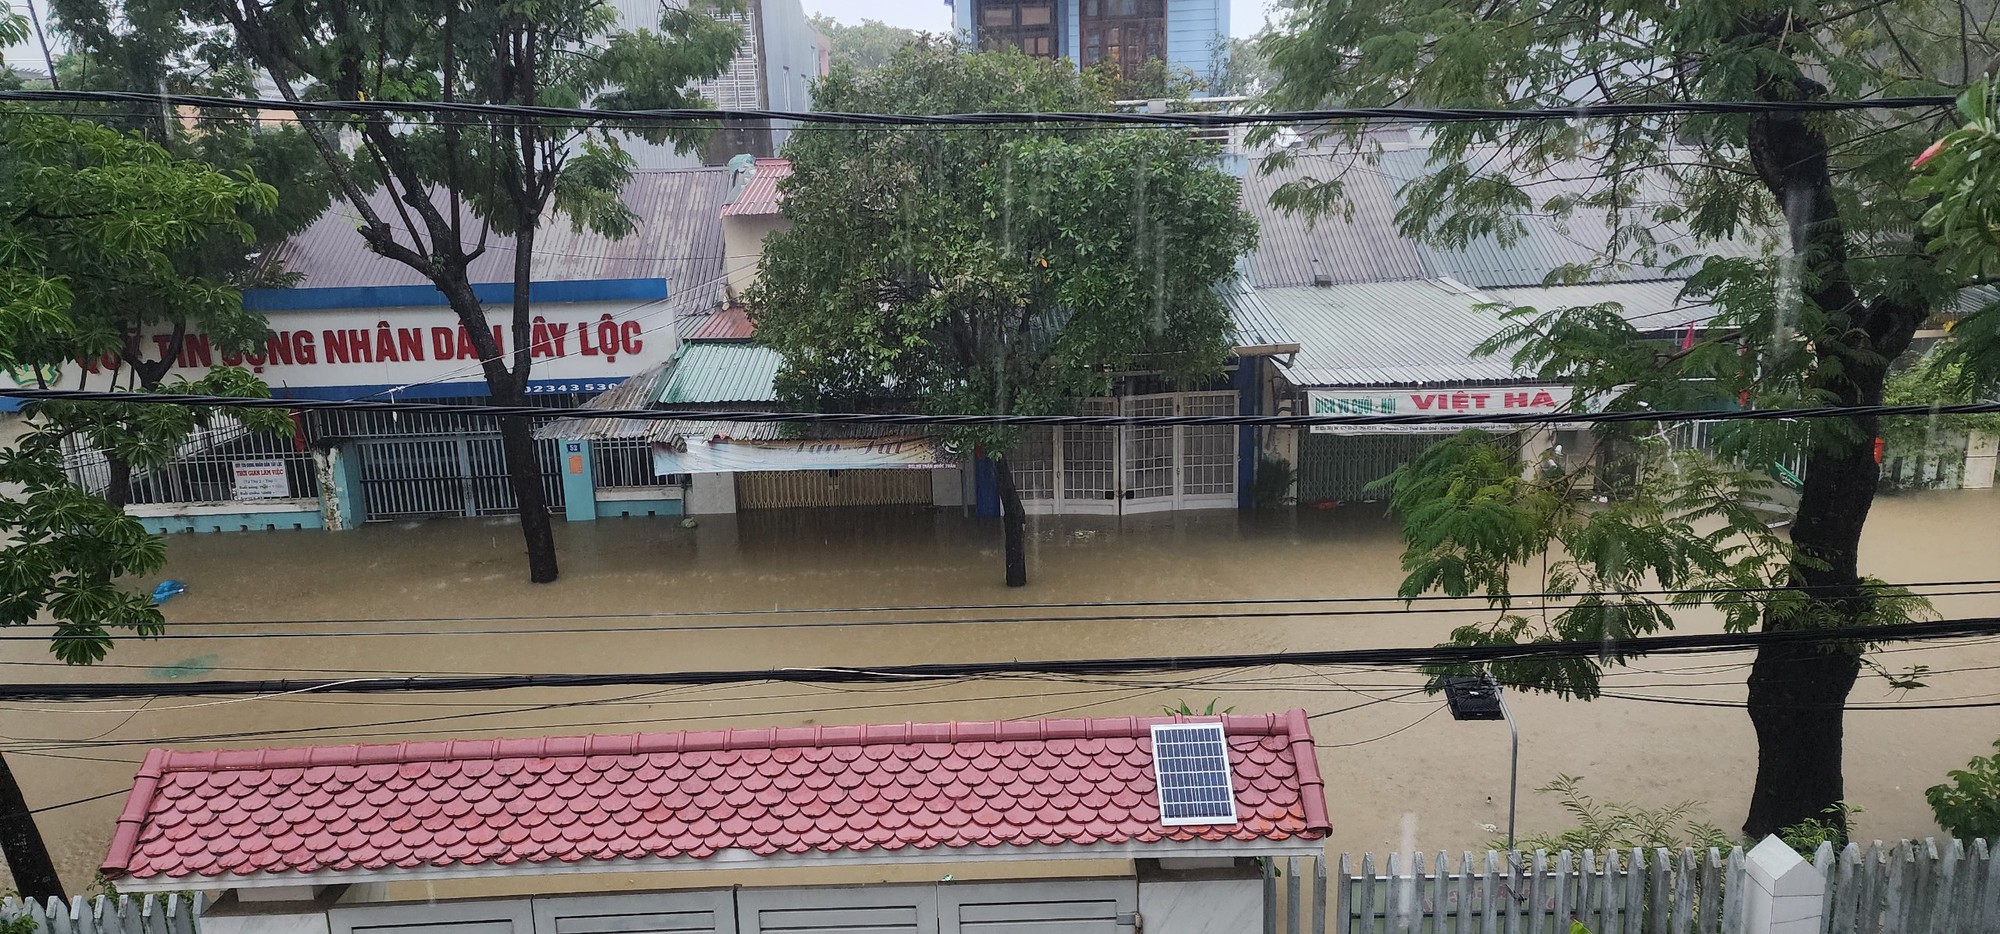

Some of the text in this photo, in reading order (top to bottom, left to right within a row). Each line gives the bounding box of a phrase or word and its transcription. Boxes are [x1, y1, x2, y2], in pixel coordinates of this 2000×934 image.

[322, 320, 425, 364] NHÂN
[530, 315, 569, 358] ÂY
[579, 313, 644, 363] LỘC
[1410, 388, 1558, 414] VIỆT HÀ
[570, 444, 579, 452] 52
